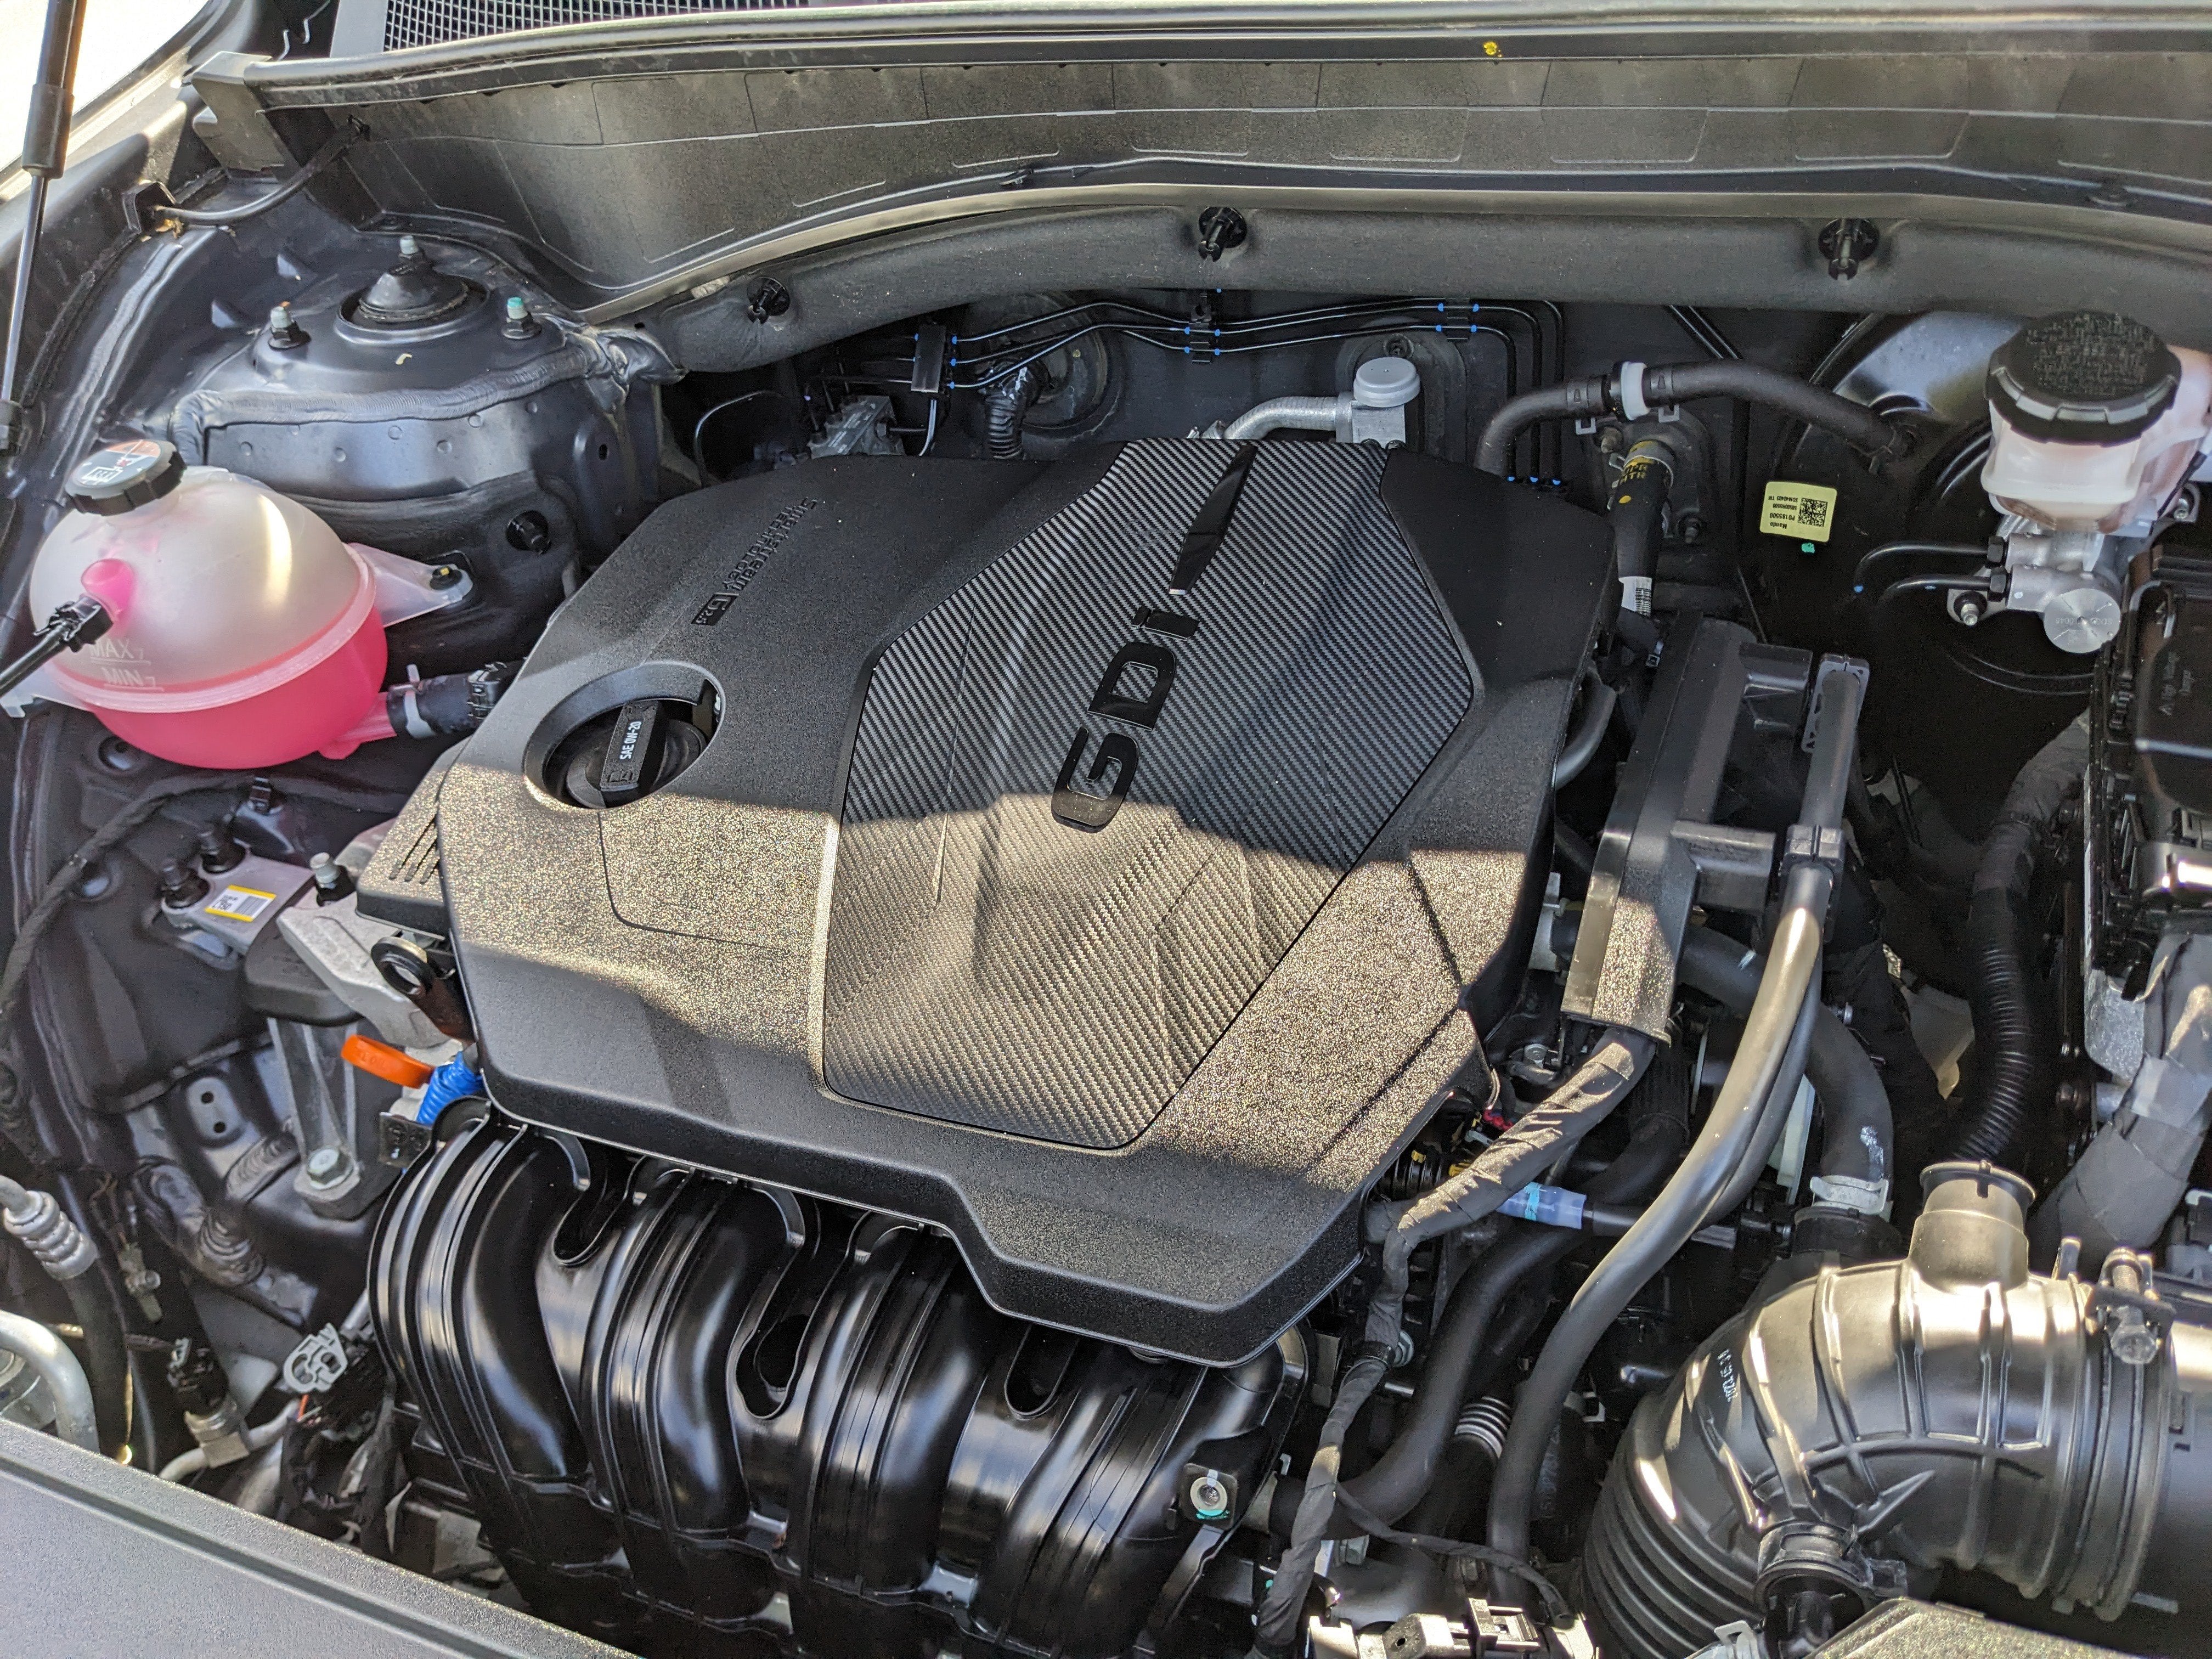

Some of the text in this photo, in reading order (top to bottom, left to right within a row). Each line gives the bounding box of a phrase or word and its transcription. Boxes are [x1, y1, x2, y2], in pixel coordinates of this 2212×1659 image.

[1769, 512, 1796, 521] P0185500
[731, 496, 818, 591] Smartstream
[89, 639, 134, 659] MAX
[101, 667, 144, 687] MIN
[619, 721, 642, 760] SAE 0W-20
